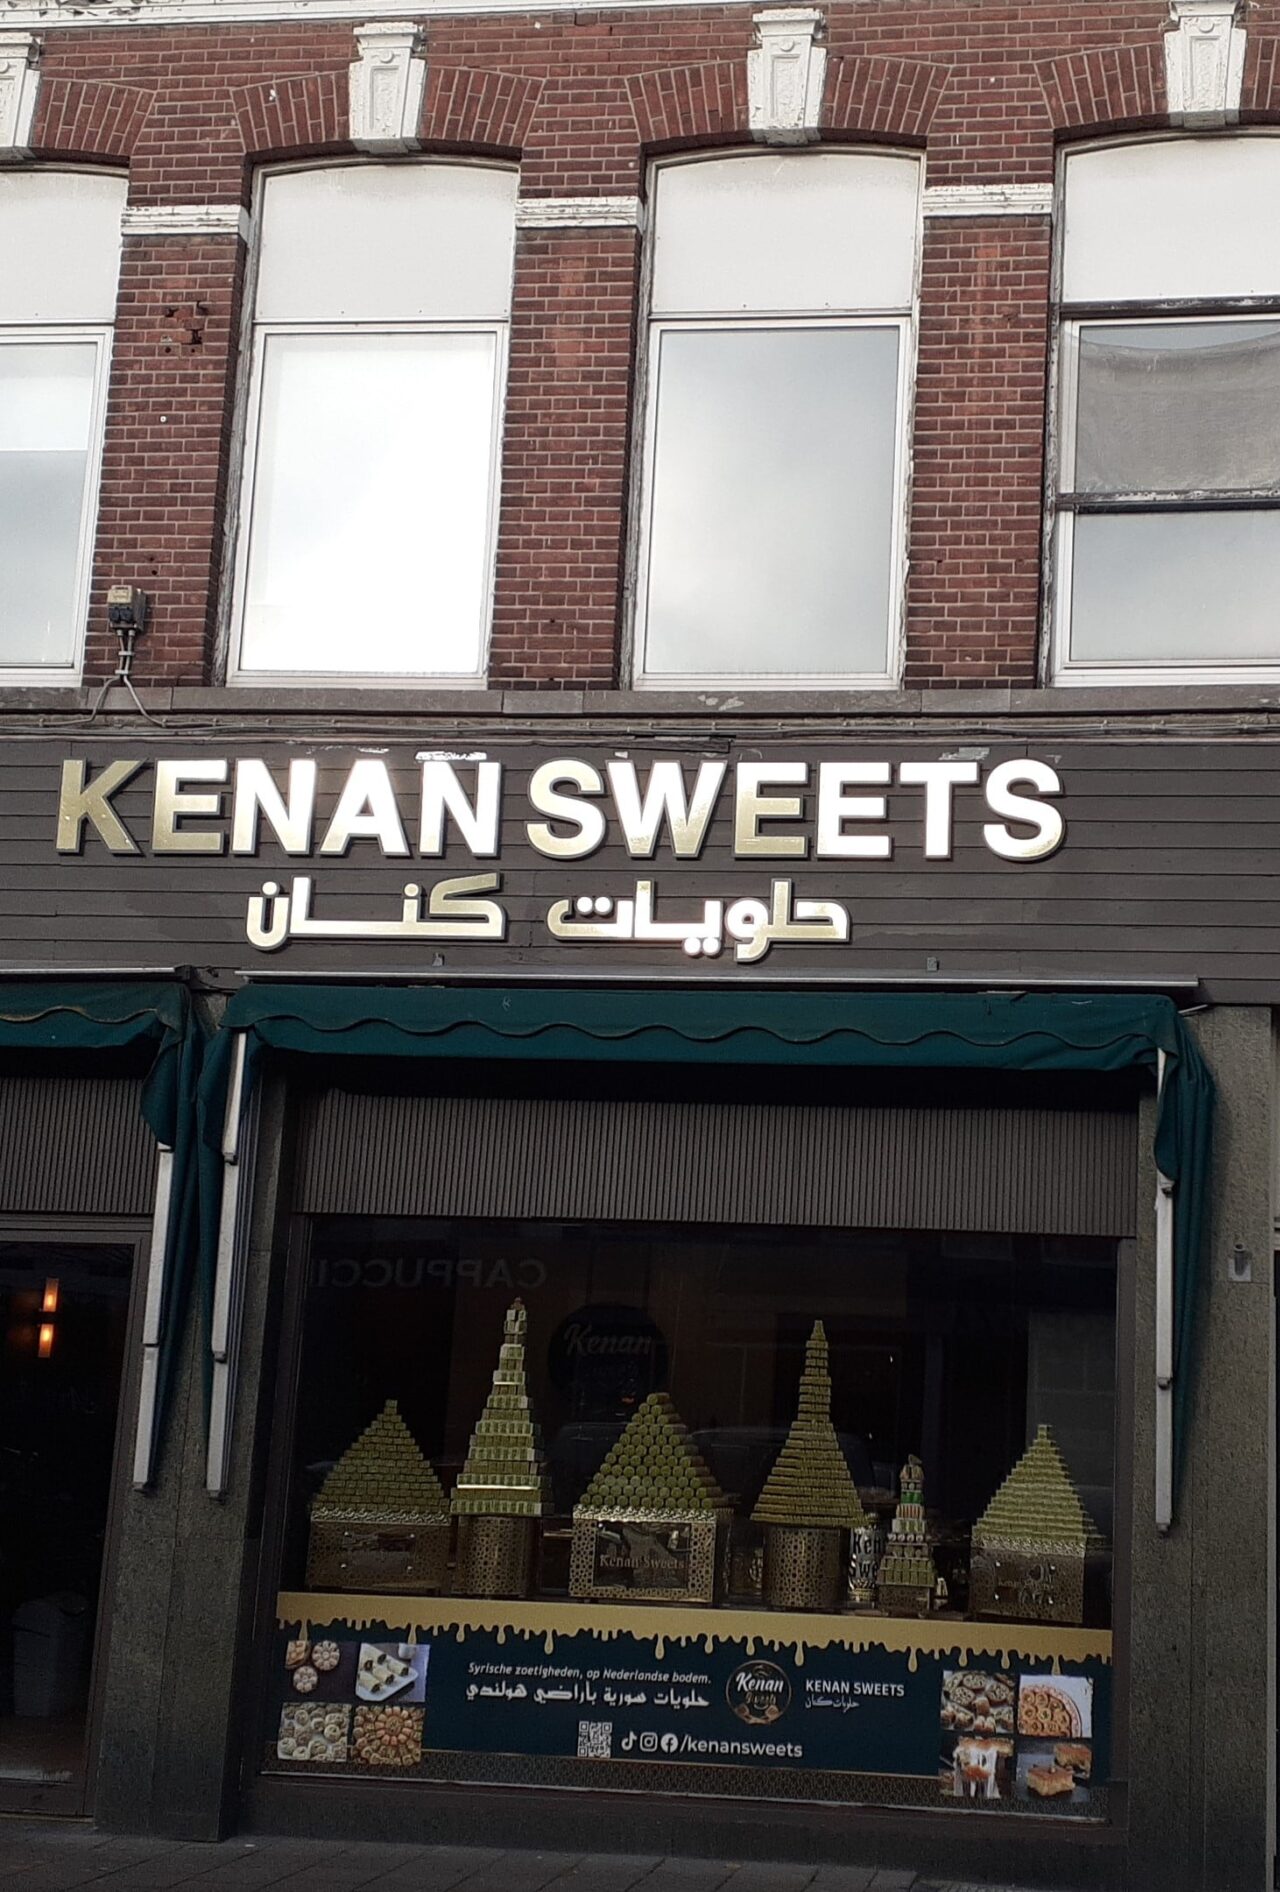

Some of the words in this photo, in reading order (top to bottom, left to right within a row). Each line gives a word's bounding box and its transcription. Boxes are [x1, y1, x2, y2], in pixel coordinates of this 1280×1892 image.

[54, 756, 500, 857] KENAN
[525, 756, 1065, 861] SWEETS
[245, 871, 505, 952] كنان
[546, 876, 851, 963] حلويات
[600, 1554, 639, 1568] Kenan
[643, 1556, 685, 1569] Sweets
[468, 1662, 512, 1675] Syrische
[514, 1664, 583, 1680] zoetigheden,
[586, 1669, 600, 1681] op
[603, 1666, 670, 1682] Nederlandse
[671, 1670, 712, 1684] bodem.
[736, 1672, 784, 1693] Kenan
[603, 1686, 647, 1707] سورية
[653, 1687, 710, 1709] حلويات
[805, 1679, 849, 1694] KENAN
[853, 1682, 905, 1697] SWEETS
